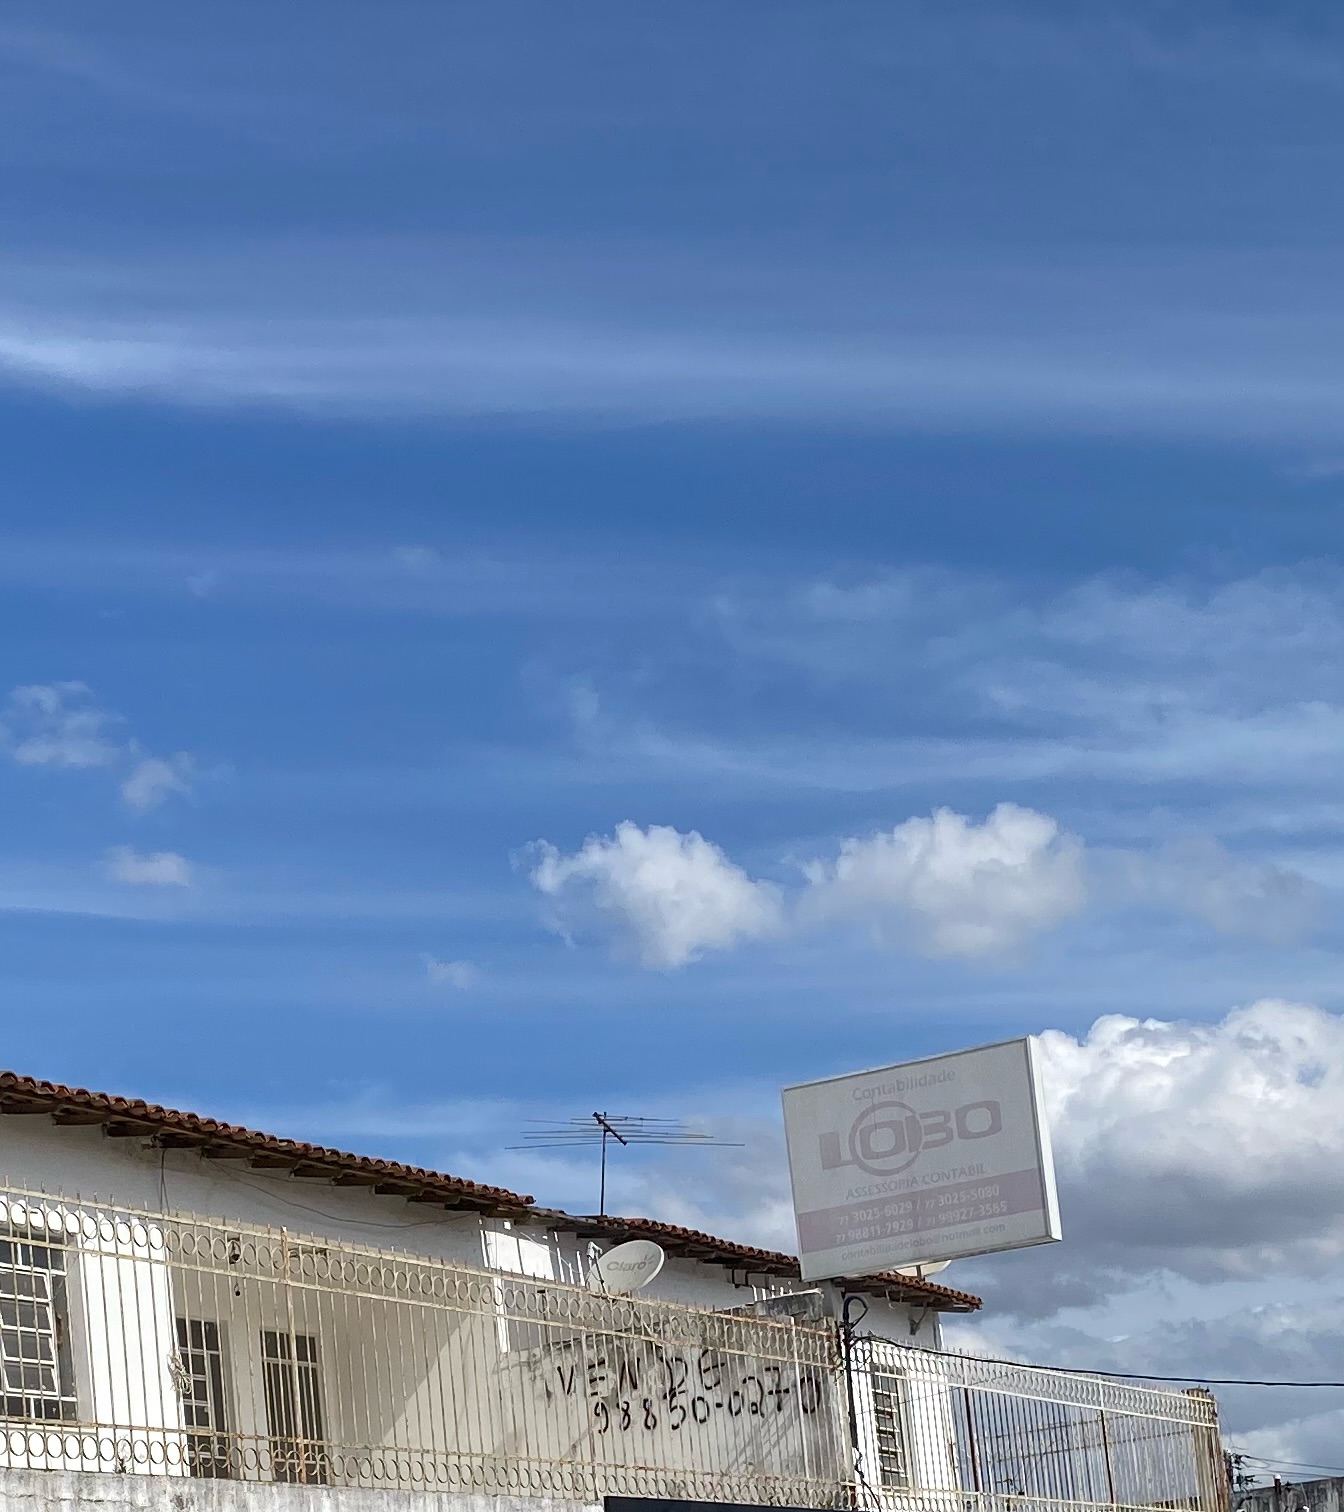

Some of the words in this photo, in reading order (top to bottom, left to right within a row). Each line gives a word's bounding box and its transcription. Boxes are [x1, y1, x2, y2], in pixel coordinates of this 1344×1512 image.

[852, 1069, 956, 1100] Contabilidade
[846, 1177, 918, 1200] ASSESSORIA
[922, 1163, 986, 1185] CONTABIL
[607, 1260, 647, 1272] Claro
